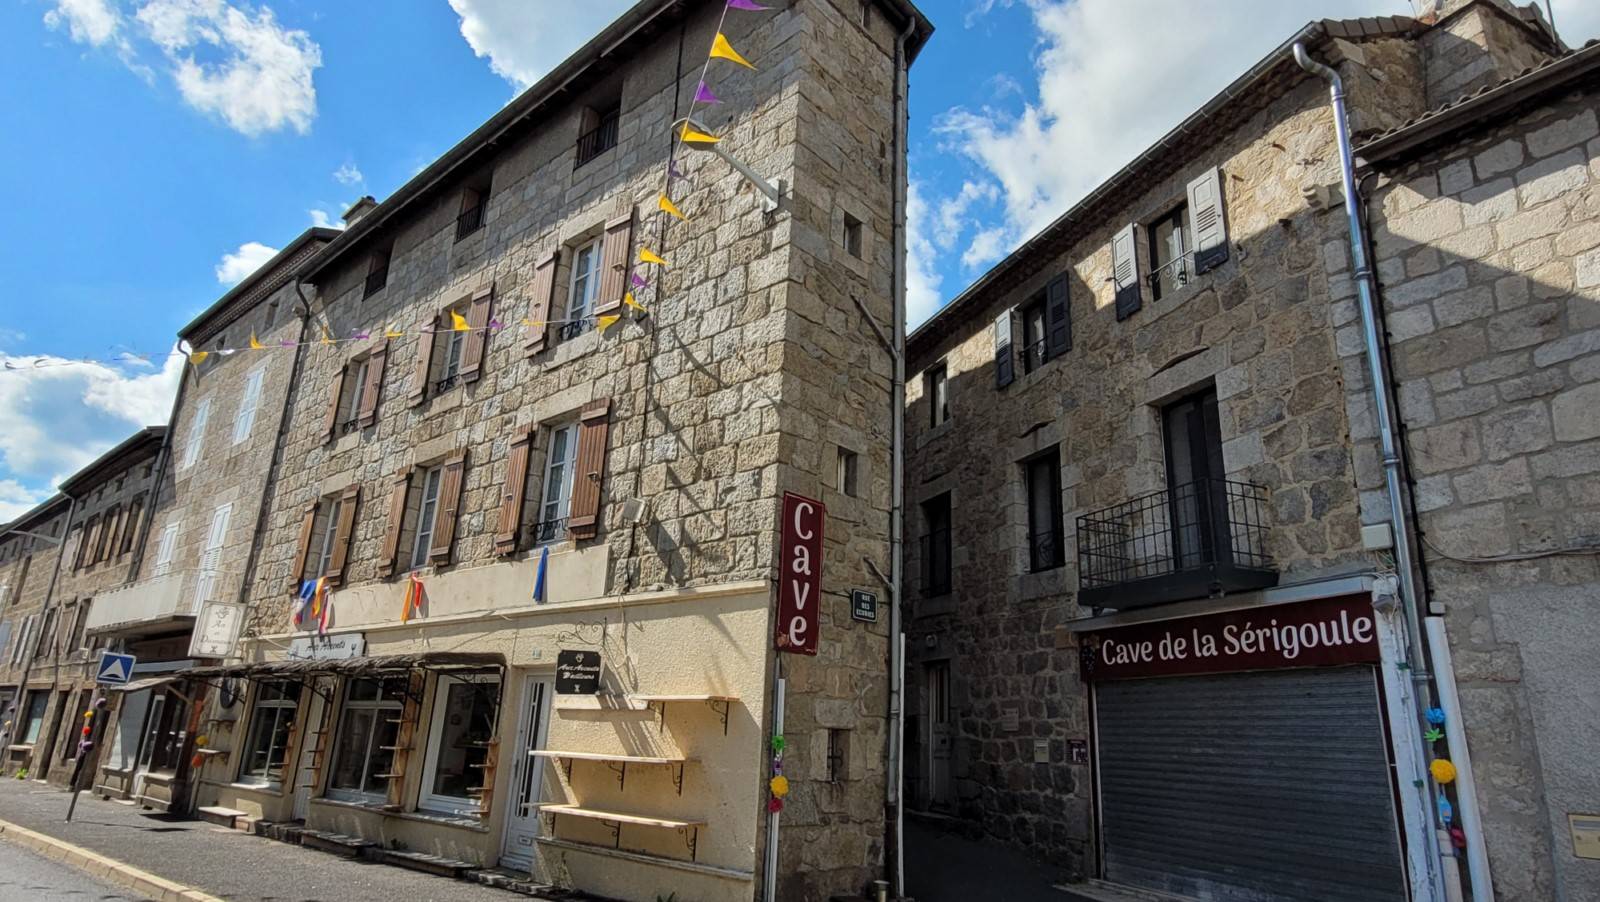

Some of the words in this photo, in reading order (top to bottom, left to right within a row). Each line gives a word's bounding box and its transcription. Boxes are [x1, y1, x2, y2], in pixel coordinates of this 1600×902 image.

[788, 502, 815, 647] Cave
[1102, 638, 1153, 665] Cave
[1158, 631, 1188, 661] de
[1193, 628, 1218, 658] la
[1223, 610, 1374, 660] Sérigoule
